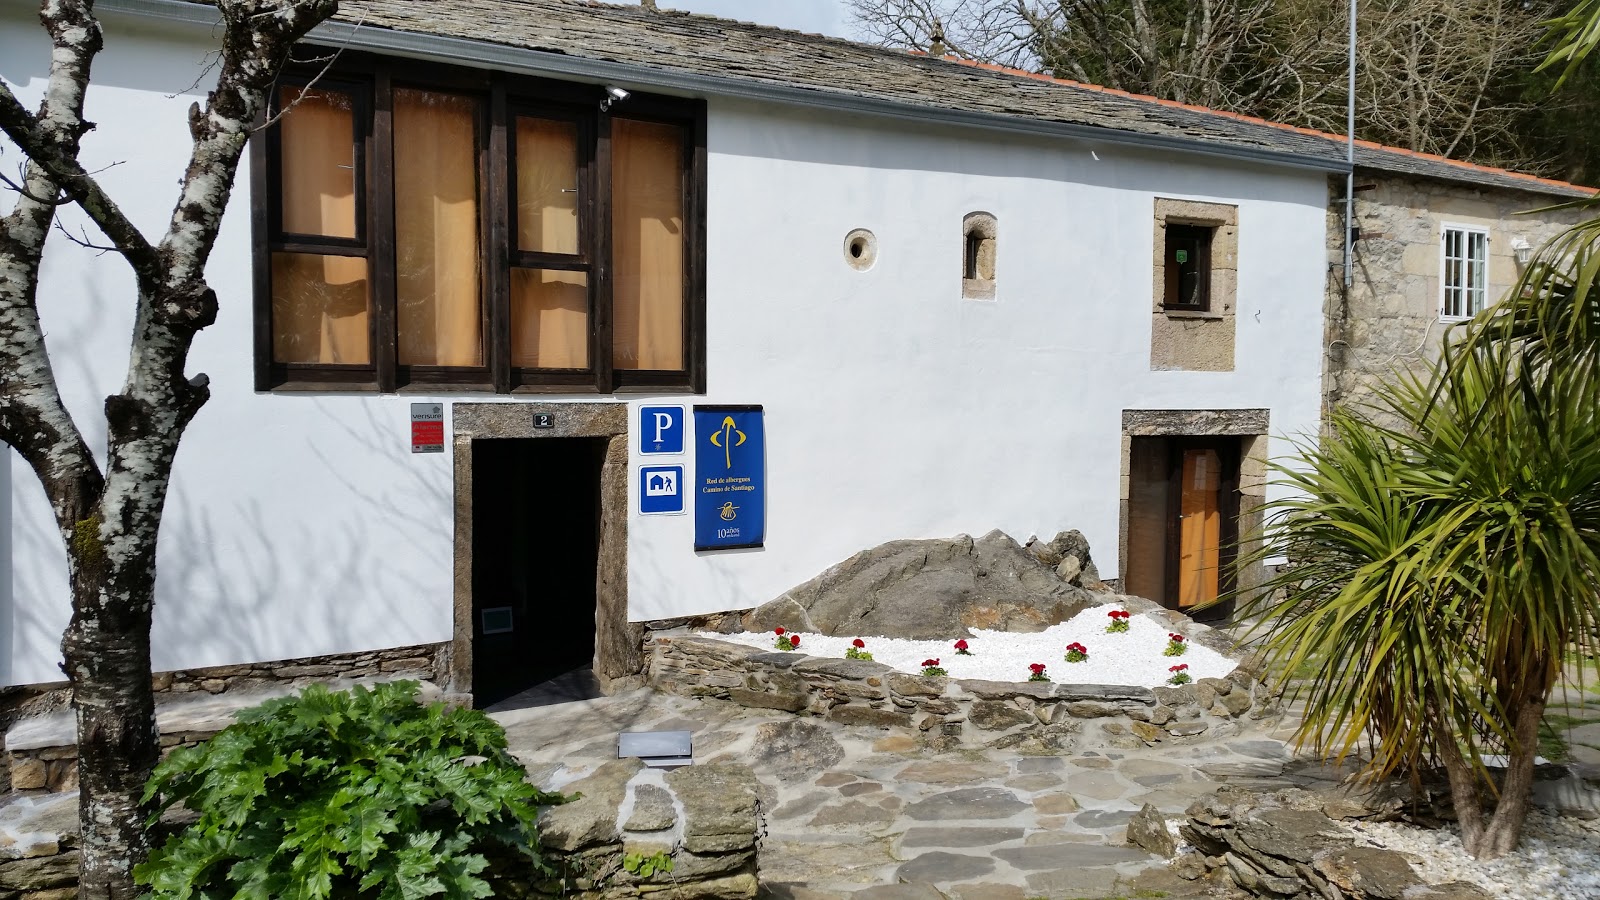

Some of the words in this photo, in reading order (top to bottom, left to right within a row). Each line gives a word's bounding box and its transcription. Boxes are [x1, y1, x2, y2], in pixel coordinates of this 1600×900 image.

[540, 415, 548, 426] 2
[652, 412, 673, 443] P
[718, 528, 726, 538] 10
